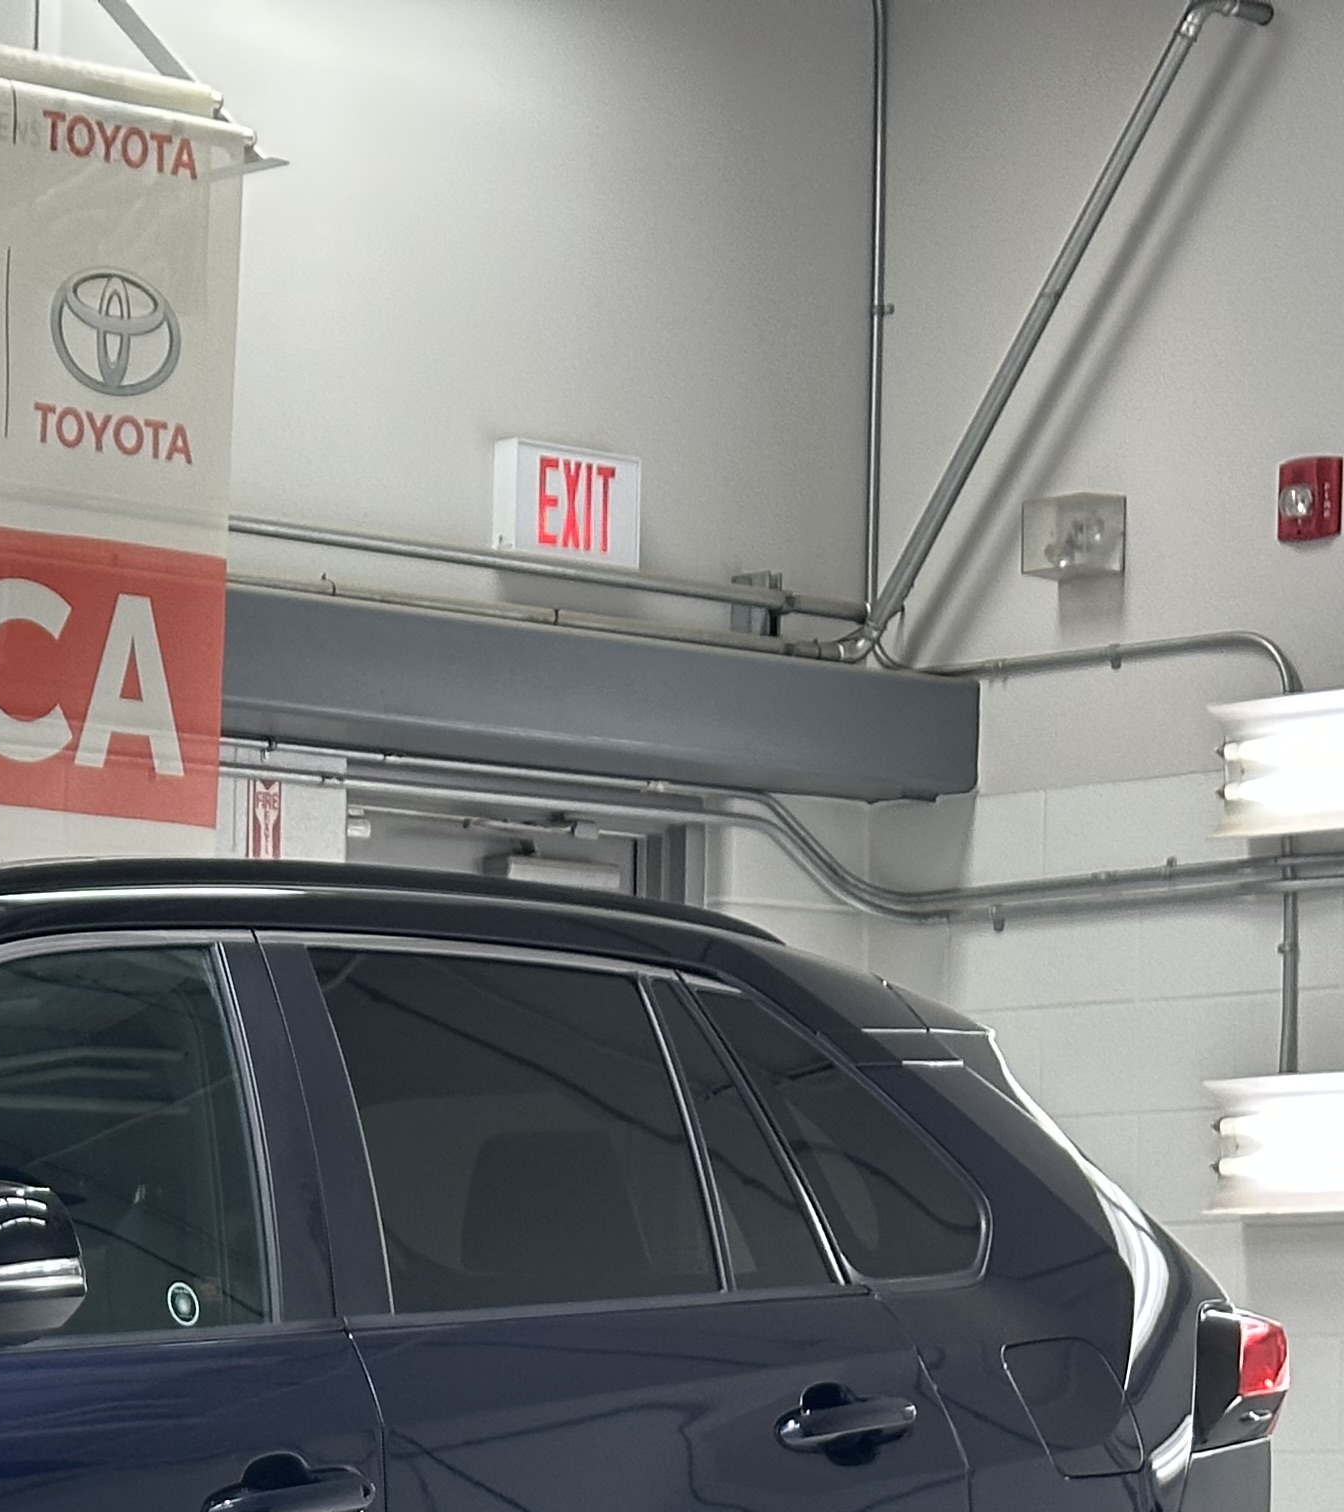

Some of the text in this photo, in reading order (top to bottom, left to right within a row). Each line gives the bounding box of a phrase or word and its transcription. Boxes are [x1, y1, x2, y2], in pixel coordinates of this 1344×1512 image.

[43, 110, 199, 181] TOYOTA
[34, 402, 193, 466] TOYOTA
[537, 455, 616, 554] EXIT
